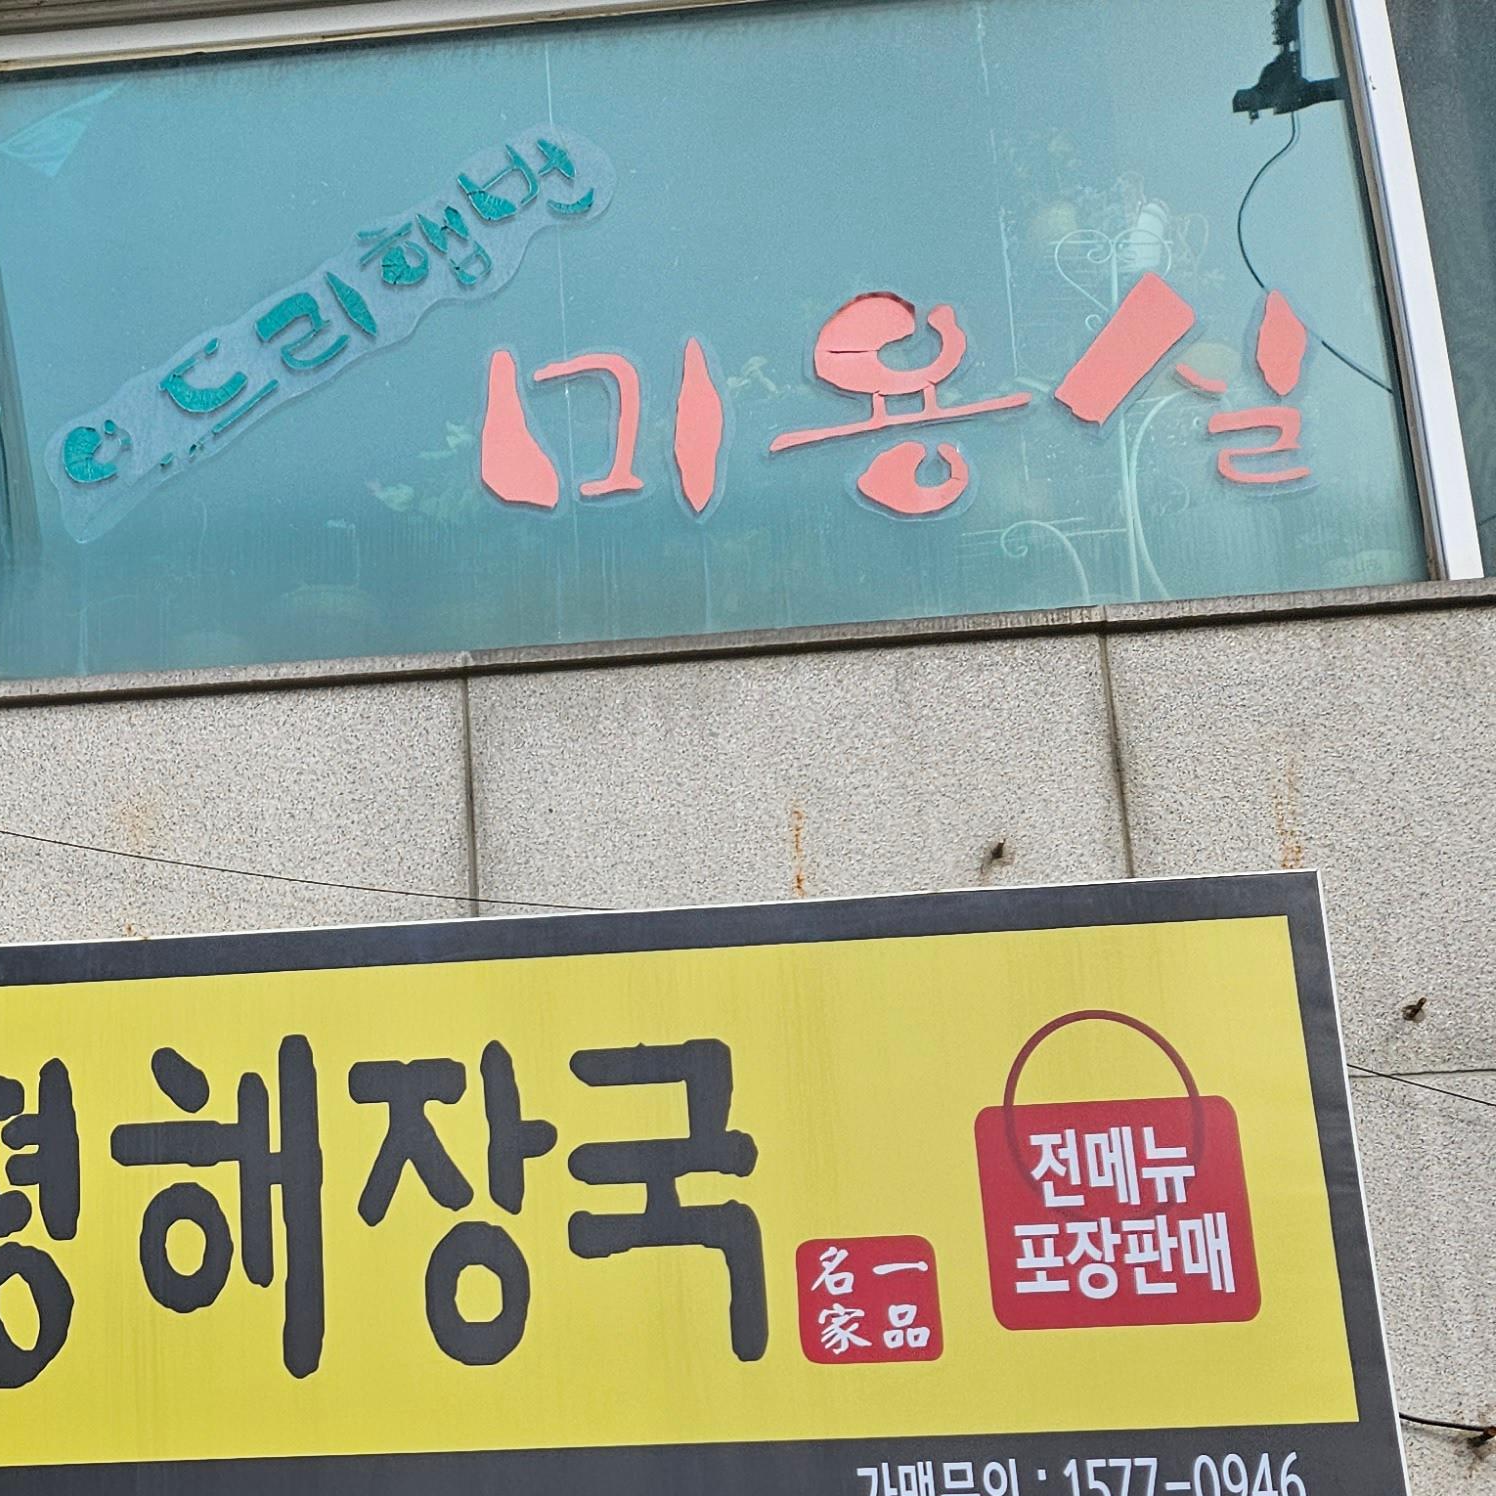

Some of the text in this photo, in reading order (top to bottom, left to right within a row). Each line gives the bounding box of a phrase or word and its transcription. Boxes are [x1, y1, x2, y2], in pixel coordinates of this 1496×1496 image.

[480, 272, 1311, 516] 미용실
[1028, 1126, 1197, 1208] 전메뉴
[1013, 1211, 1236, 1300] 포장판매
